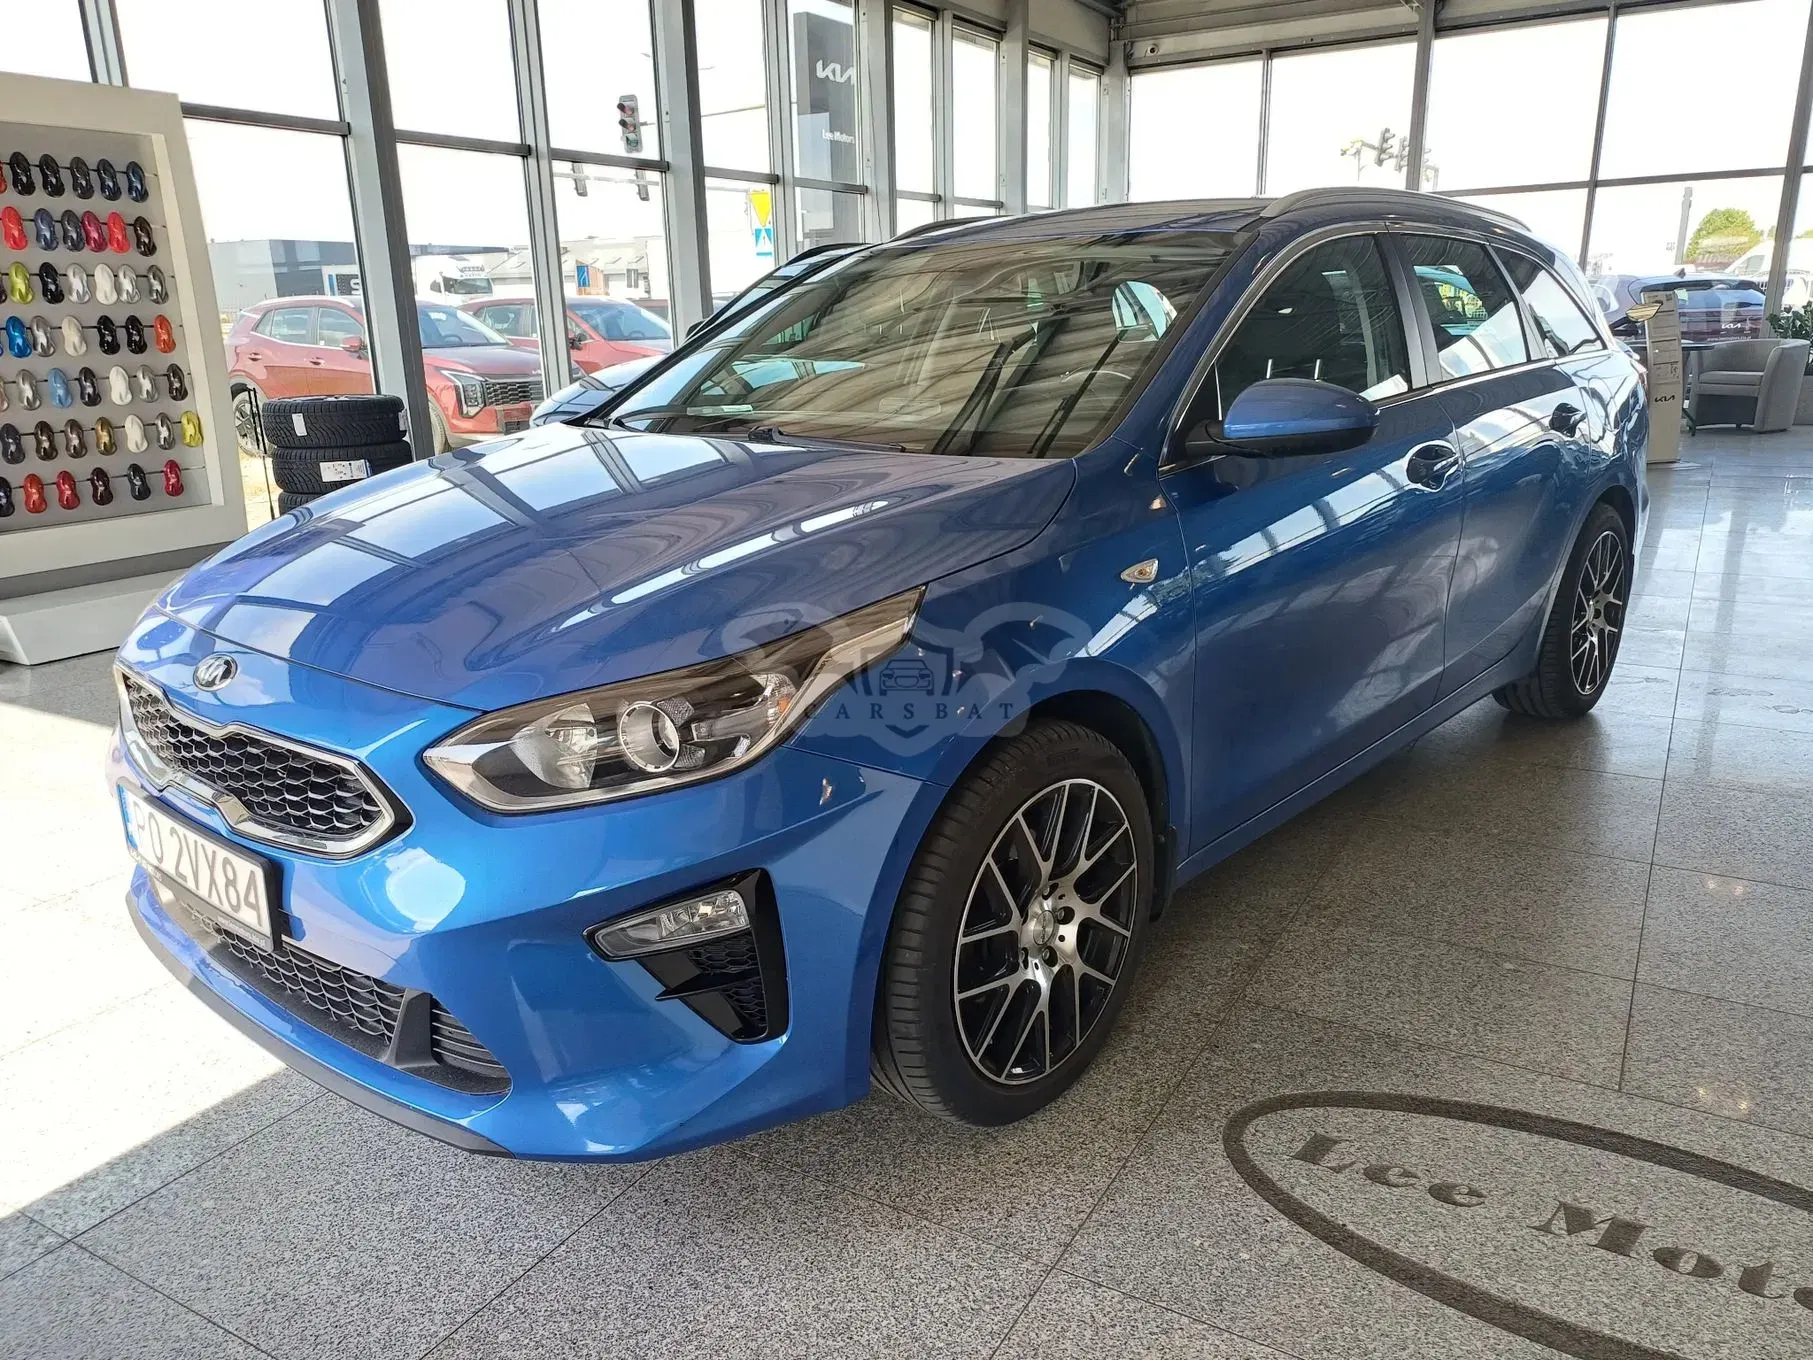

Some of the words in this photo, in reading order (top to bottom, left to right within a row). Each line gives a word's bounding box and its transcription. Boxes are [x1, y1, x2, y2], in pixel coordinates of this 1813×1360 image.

[816, 59, 855, 85] KIA
[822, 129, 833, 140] Lee
[1654, 394, 1676, 403] KIA
[169, 826, 264, 929] 2VX84
[1287, 1131, 1489, 1208] Lee
